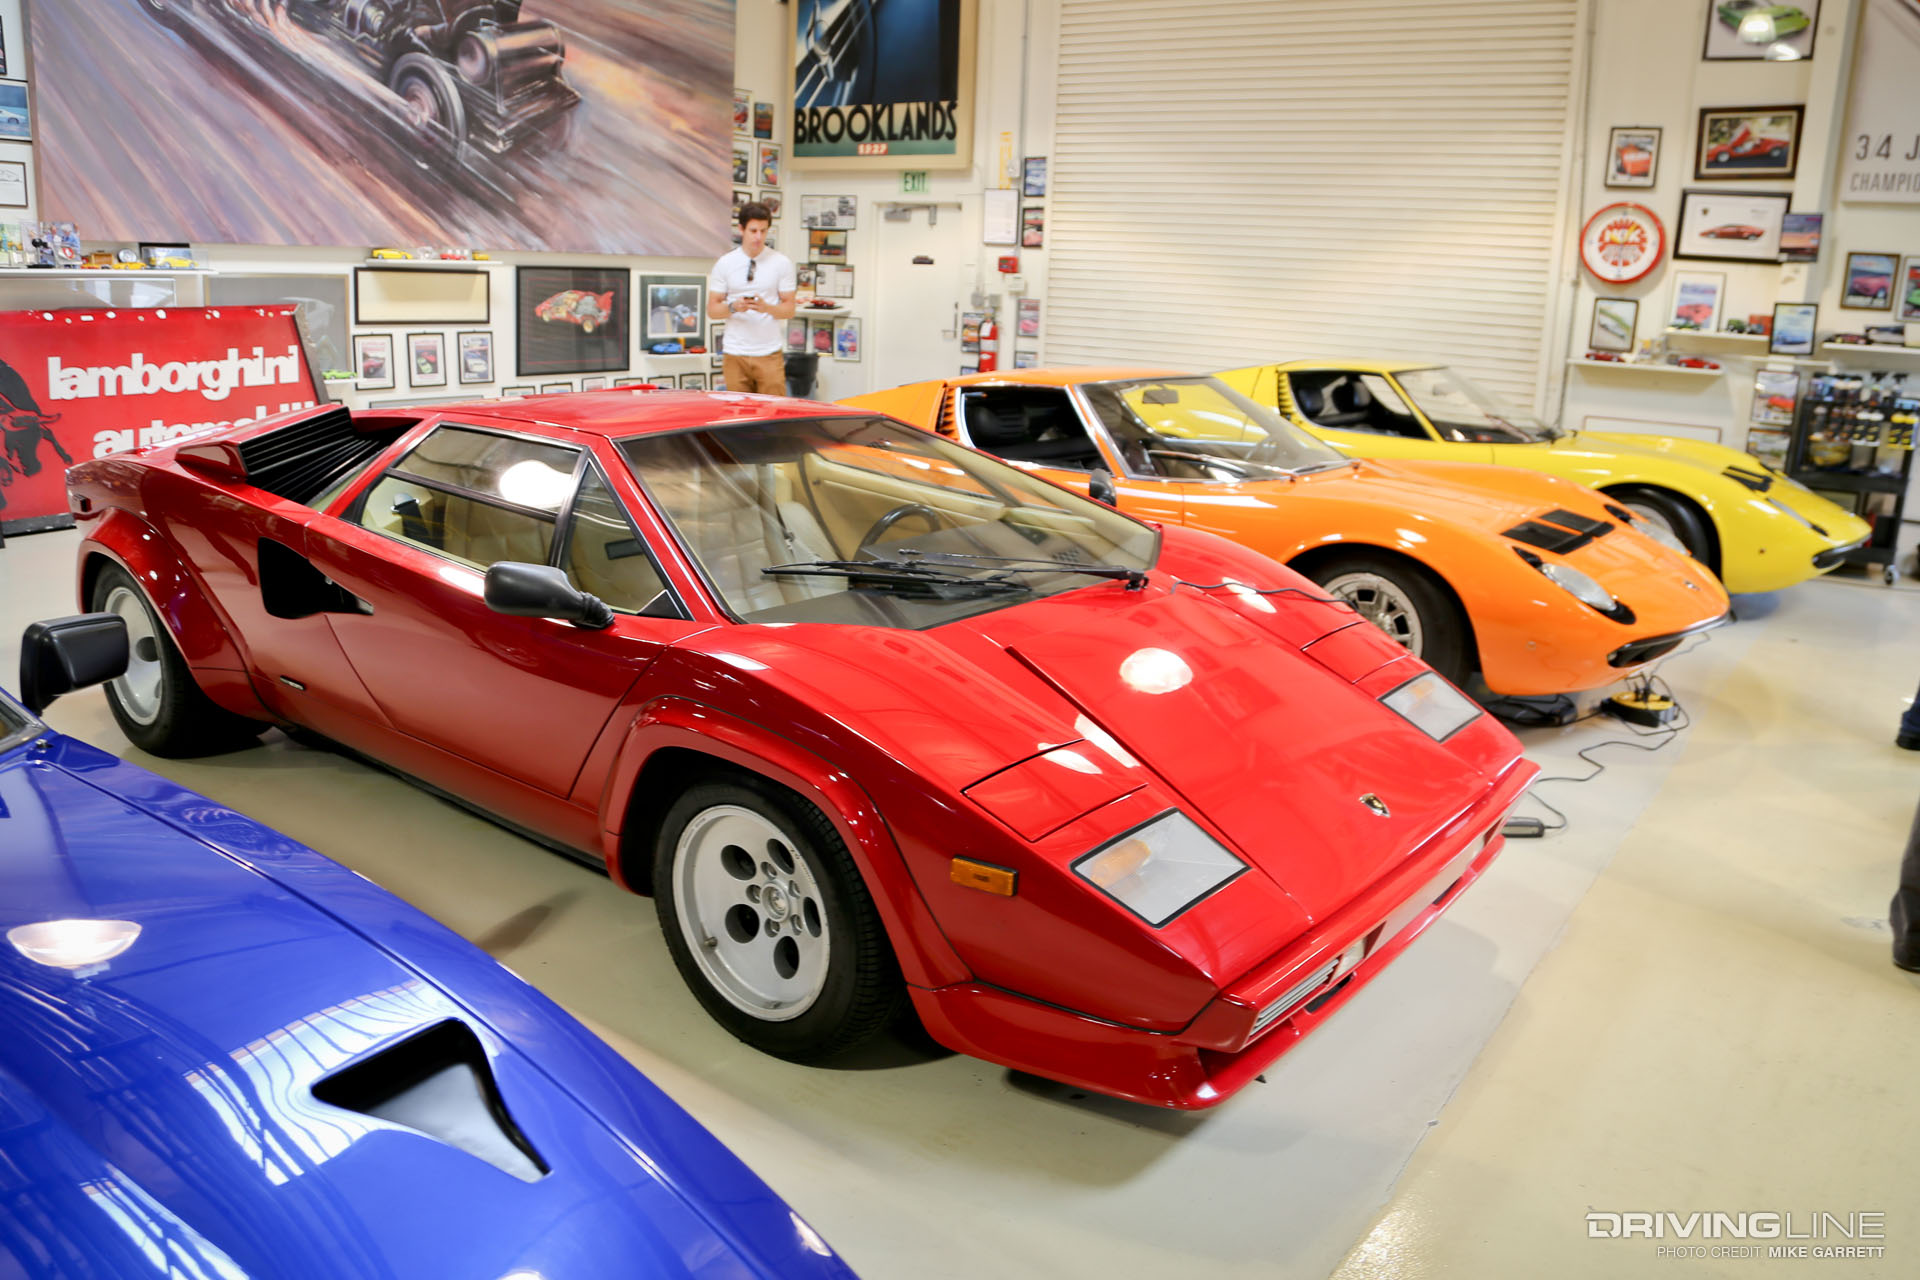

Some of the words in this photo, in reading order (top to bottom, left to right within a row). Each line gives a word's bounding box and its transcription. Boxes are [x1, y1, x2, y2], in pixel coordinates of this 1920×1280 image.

[794, 101, 958, 144] BROOKLANDS
[904, 172, 926, 192] EXIT
[48, 345, 299, 401] lamborghini
